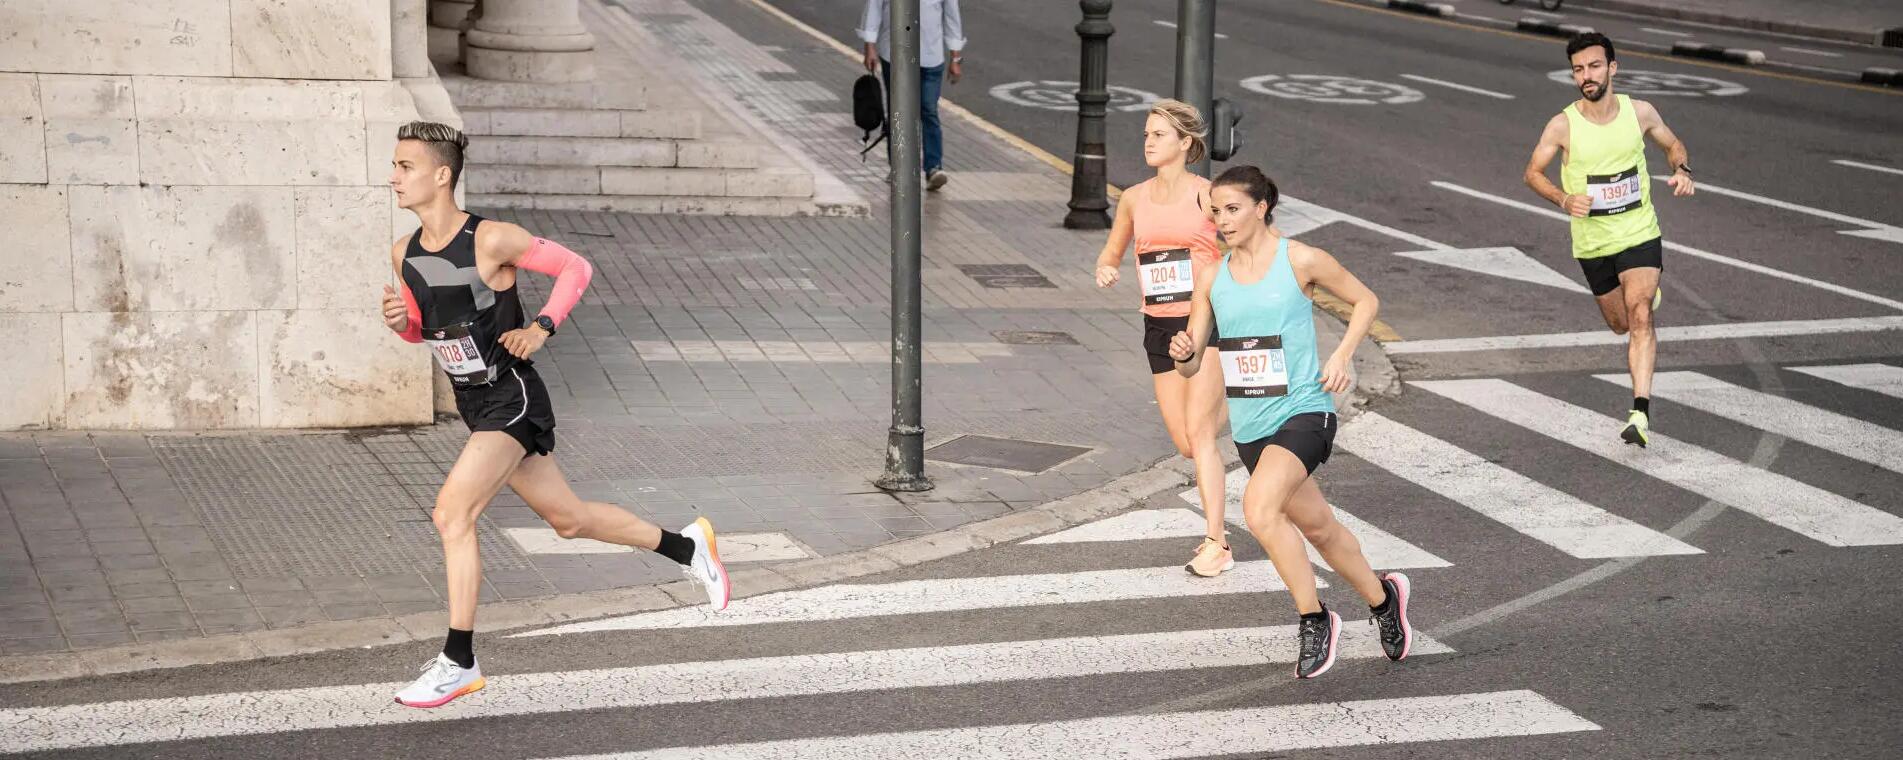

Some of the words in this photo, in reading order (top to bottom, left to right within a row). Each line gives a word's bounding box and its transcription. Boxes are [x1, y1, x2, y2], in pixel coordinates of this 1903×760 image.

[1601, 183, 1629, 200] 1392
[1150, 266, 1177, 284] 1204
[1235, 354, 1267, 374] 1597
